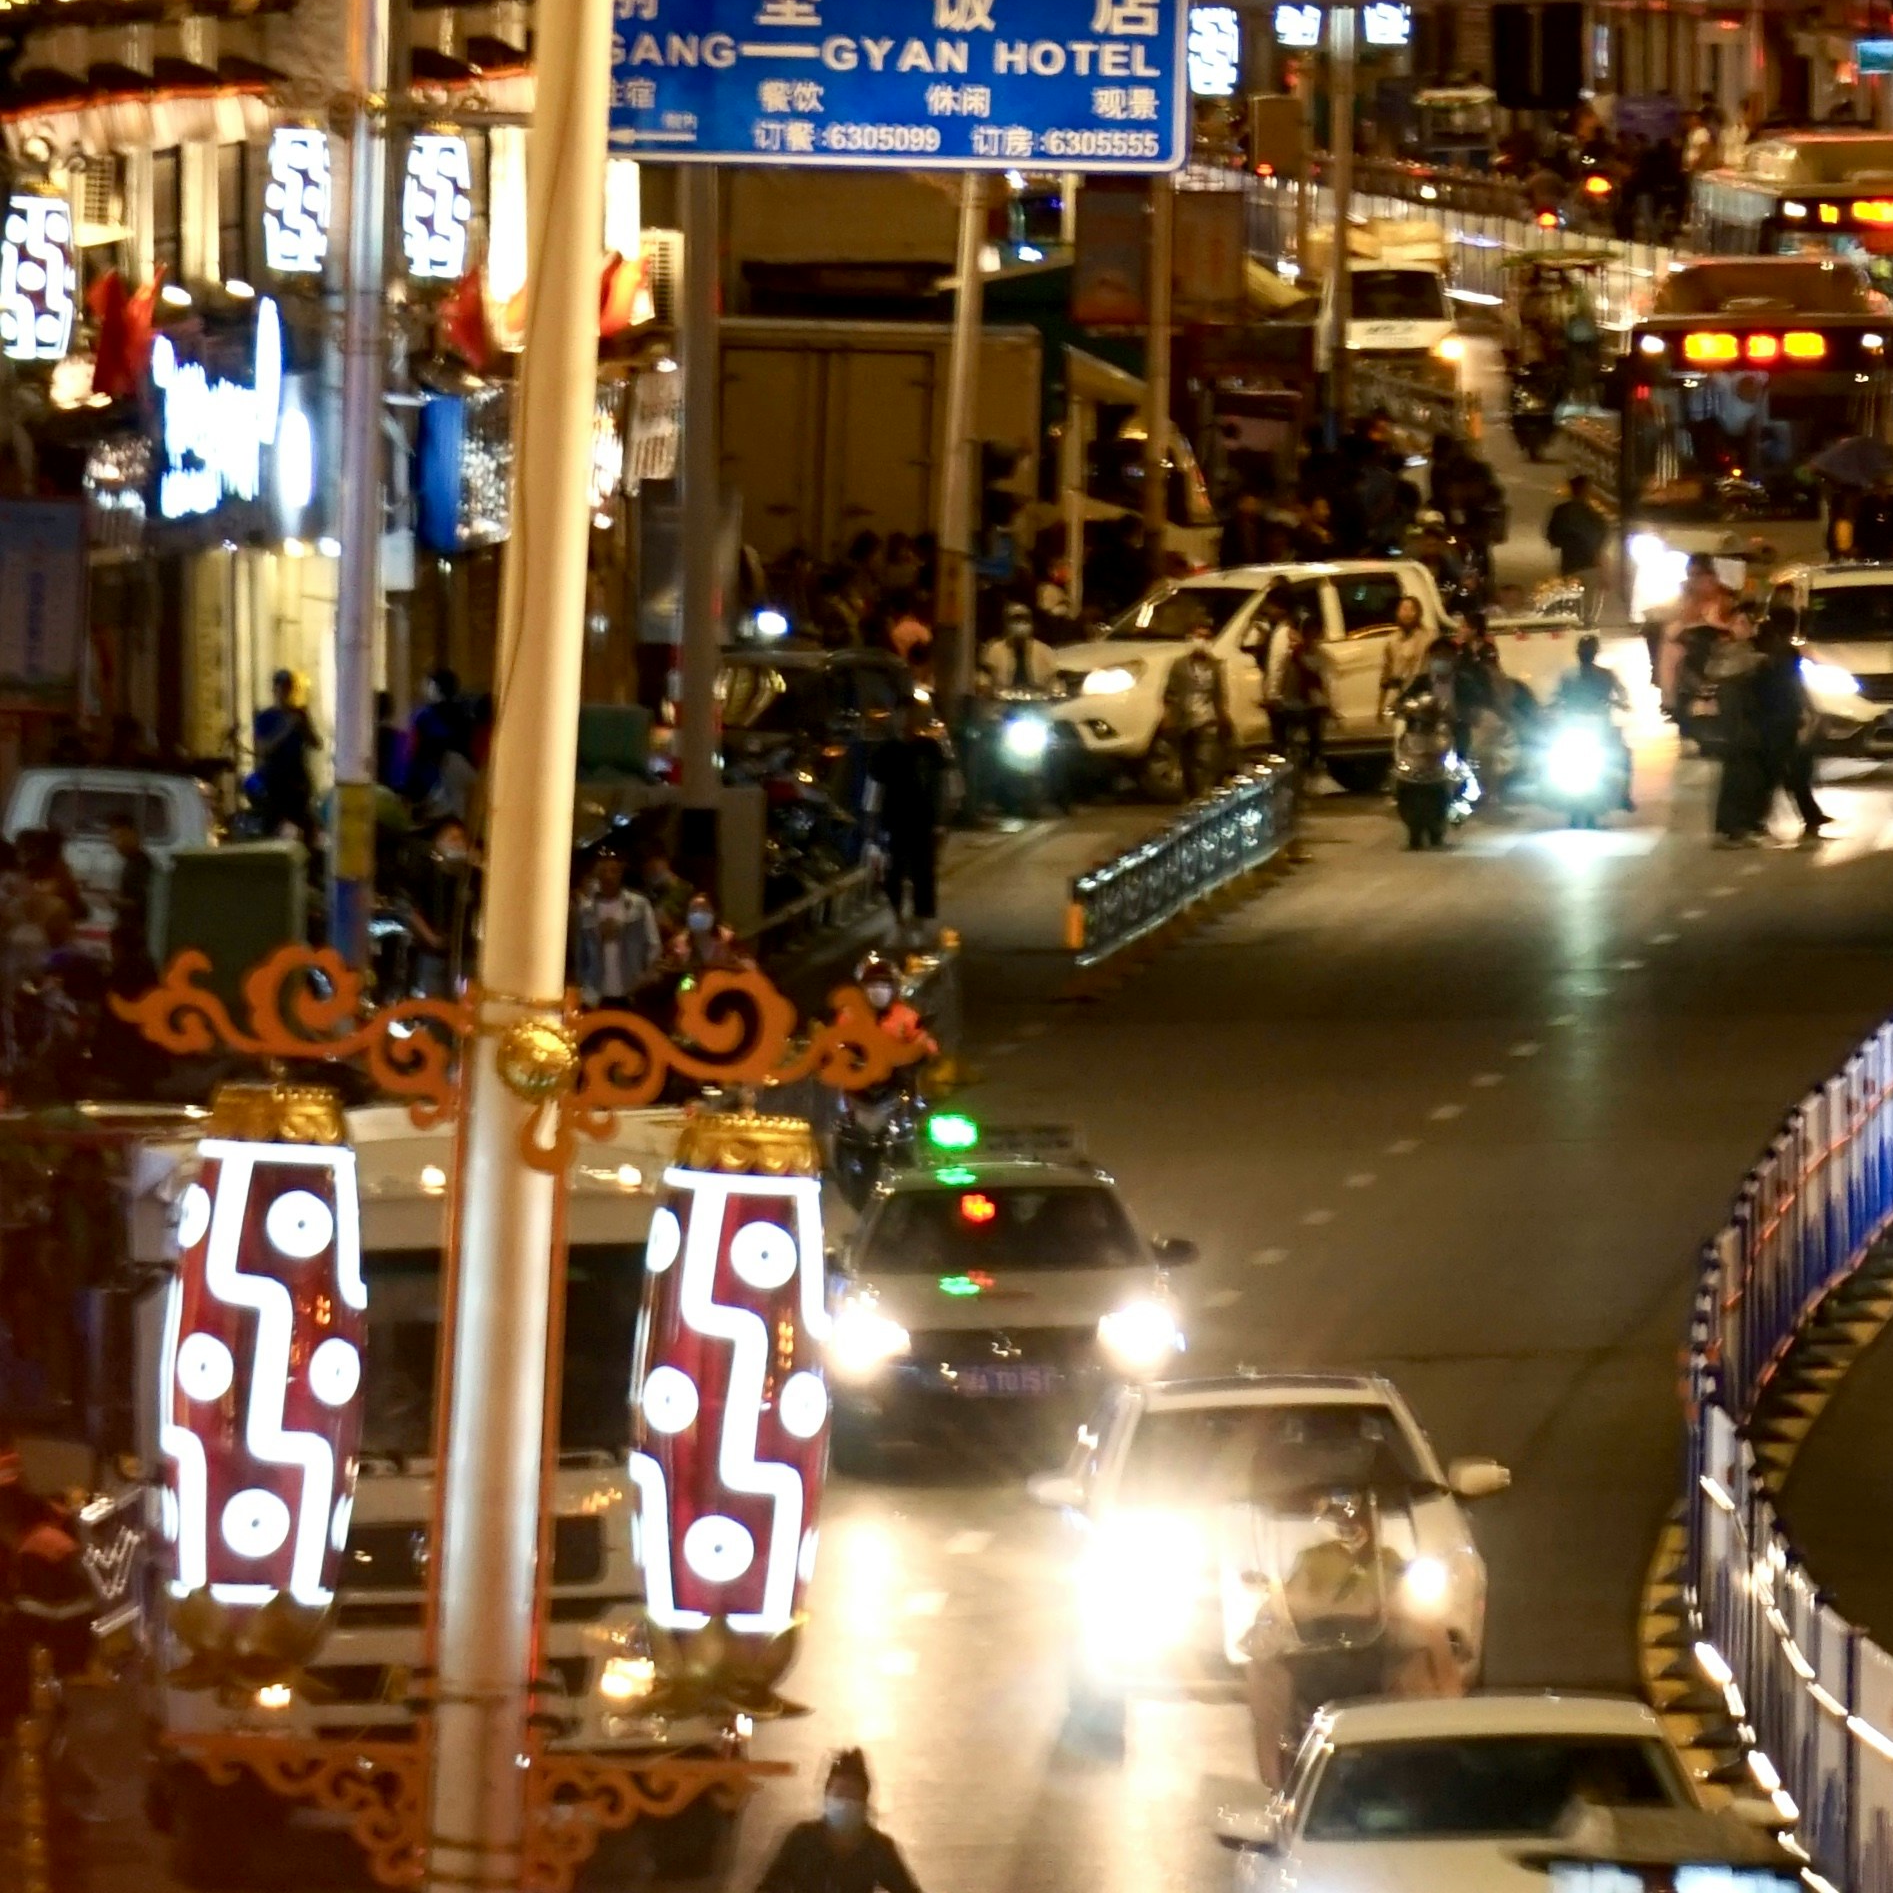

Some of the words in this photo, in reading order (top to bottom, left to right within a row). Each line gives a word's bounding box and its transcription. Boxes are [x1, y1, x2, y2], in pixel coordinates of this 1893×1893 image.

[992, 39, 1161, 78] HOTEL
[757, 78, 825, 113] 餐饮
[924, 82, 991, 118] 休闲
[1092, 86, 1159, 120] 观景
